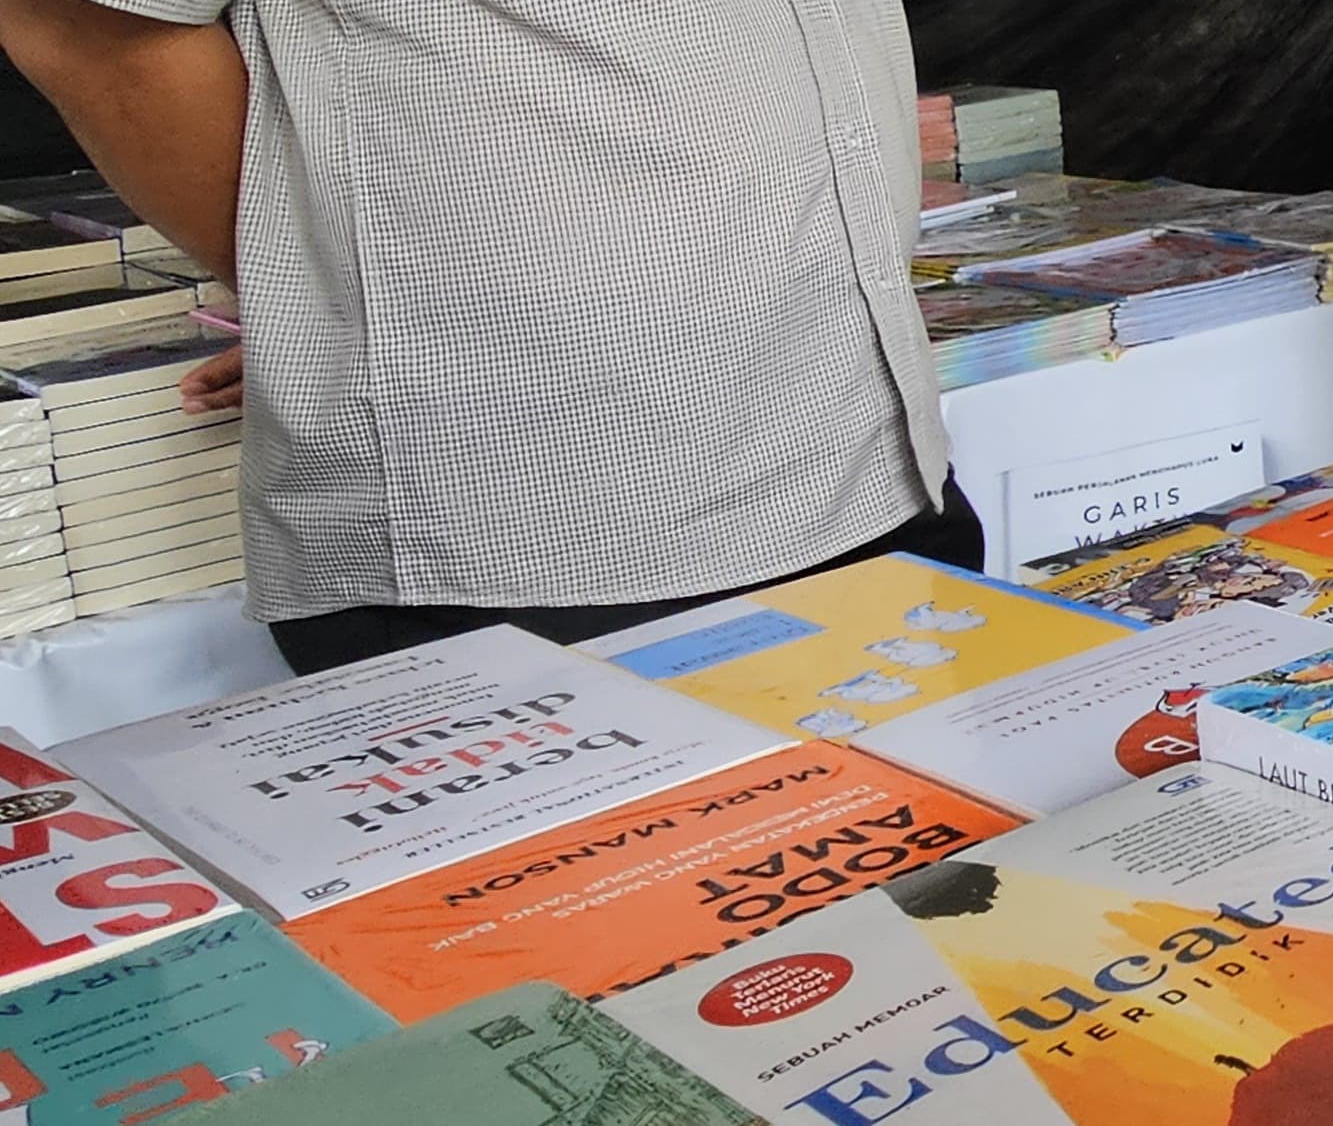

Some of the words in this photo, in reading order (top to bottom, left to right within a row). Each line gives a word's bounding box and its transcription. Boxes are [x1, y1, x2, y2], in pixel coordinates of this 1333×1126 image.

[1083, 487, 1181, 525] GARIS
[249, 690, 577, 801] disukai
[325, 721, 575, 796] tidak
[336, 729, 648, 834] berani
[533, 758, 685, 817] INTERNATIONAL
[686, 763, 831, 820] MARK
[1258, 755, 1310, 797] LAUT
[443, 817, 677, 908] MANSON
[582, 853, 666, 893] HIDUP
[666, 848, 728, 881] YANG
[695, 803, 916, 905] AMAT
[717, 823, 971, 924] BODO
[500, 886, 580, 925] YANG
[551, 876, 656, 919] WARAS
[428, 918, 498, 953] BAIK
[730, 965, 807, 1000] Terlaris
[732, 962, 787, 990] Buku
[733, 966, 827, 1011] Menurut
[739, 992, 790, 1019] New
[786, 972, 835, 1000] York
[1048, 932, 1306, 1058] TERDIDIK
[770, 984, 830, 1016] Times
[756, 1030, 854, 1082] SEBUAH
[856, 984, 952, 1033] MEMOAR
